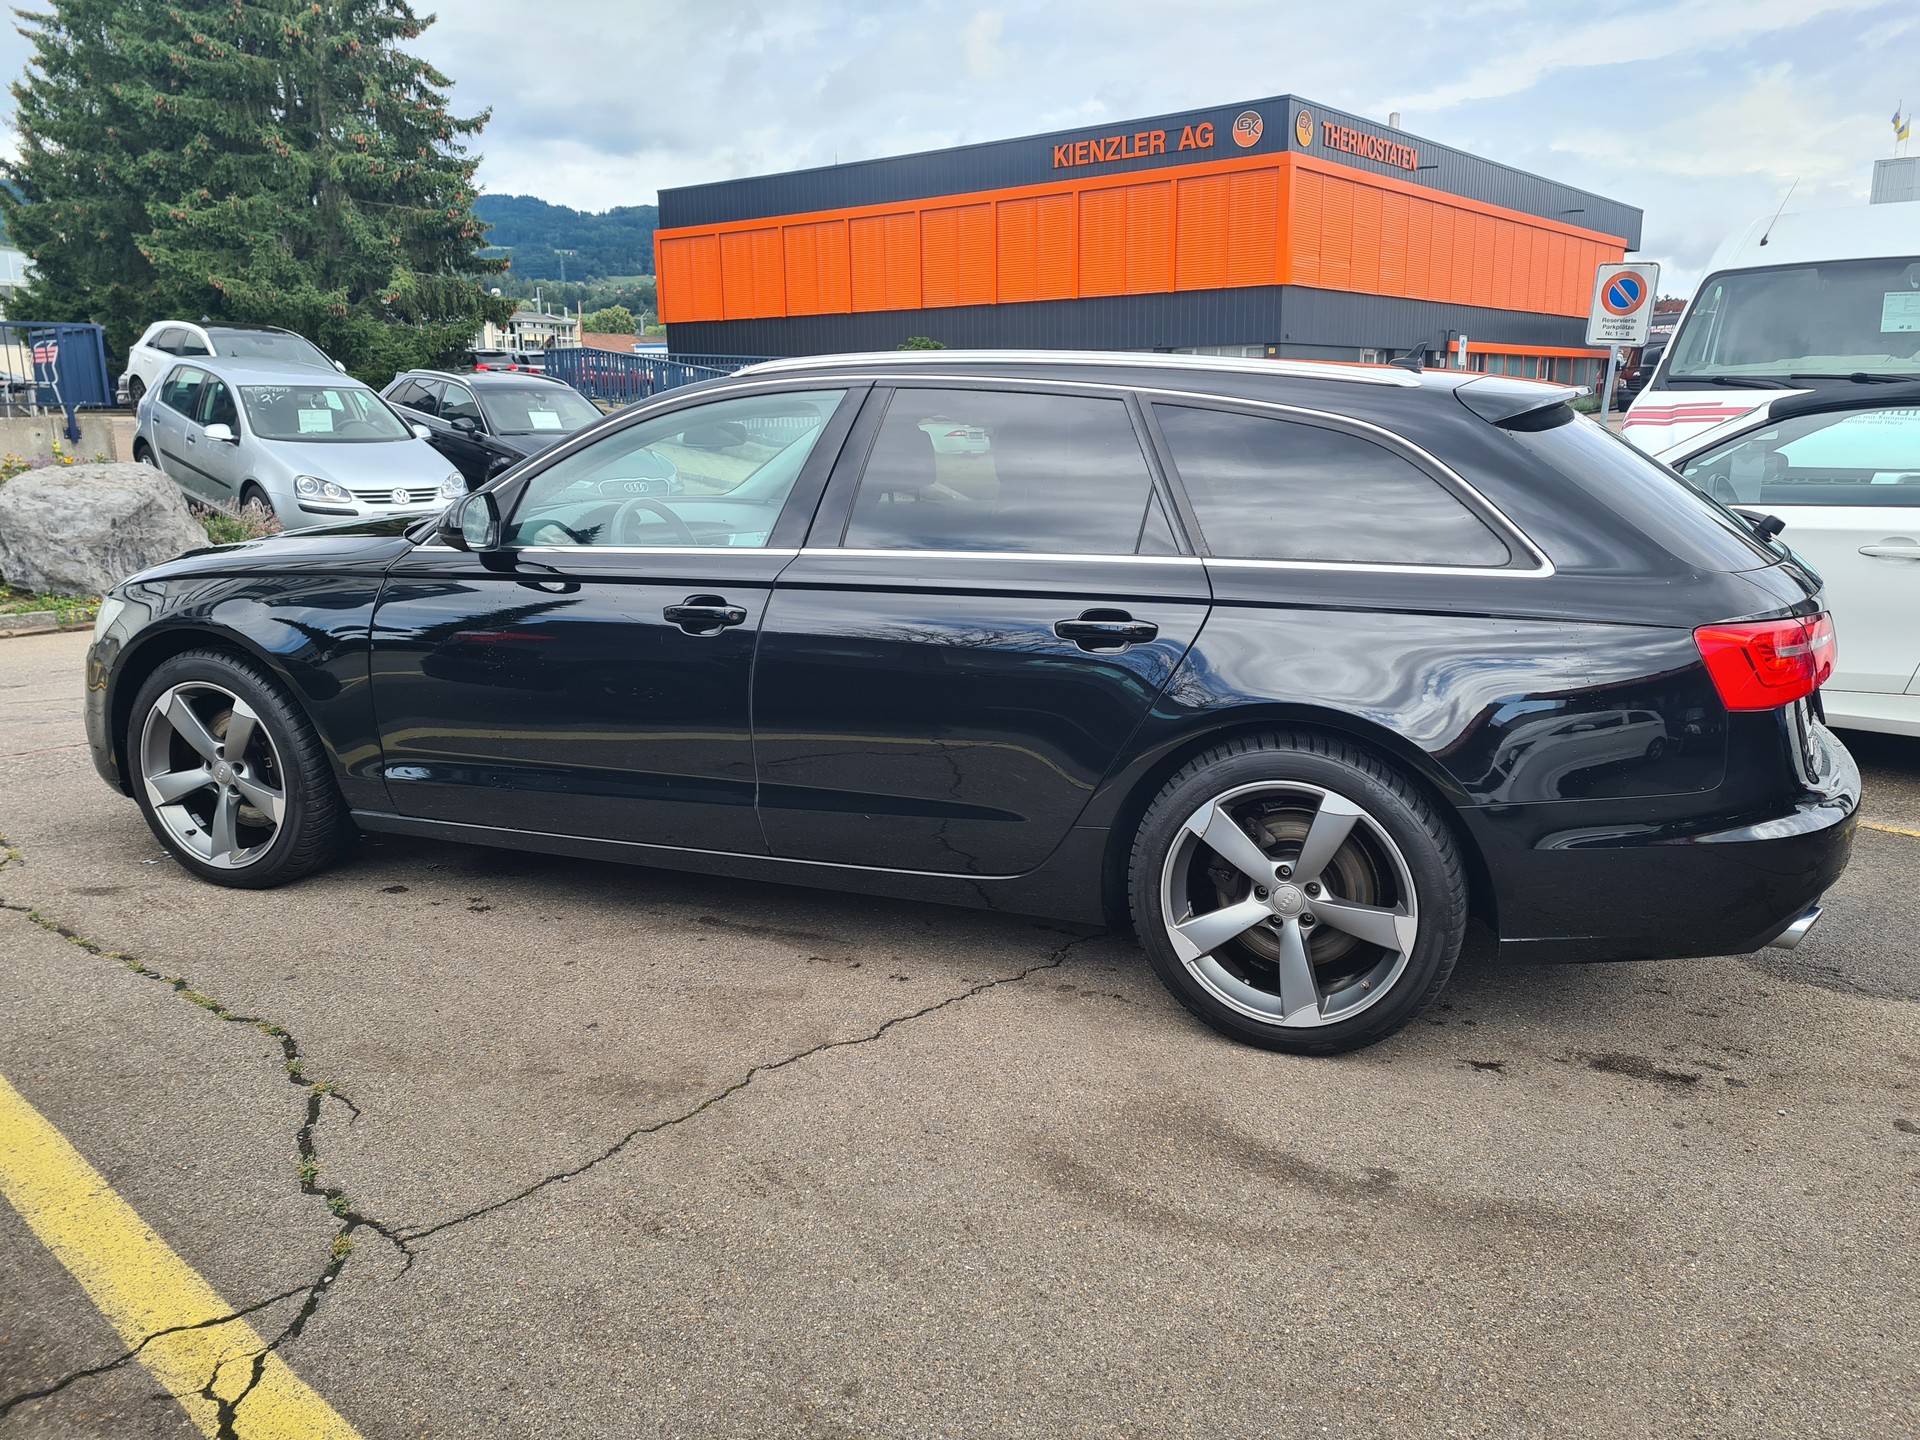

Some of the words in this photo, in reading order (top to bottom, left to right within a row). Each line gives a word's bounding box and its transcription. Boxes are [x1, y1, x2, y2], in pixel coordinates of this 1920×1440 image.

[1053, 129, 1165, 169] KIENZLER
[1177, 122, 1214, 151] AG
[1321, 120, 1419, 171] THERMOSTATEN
